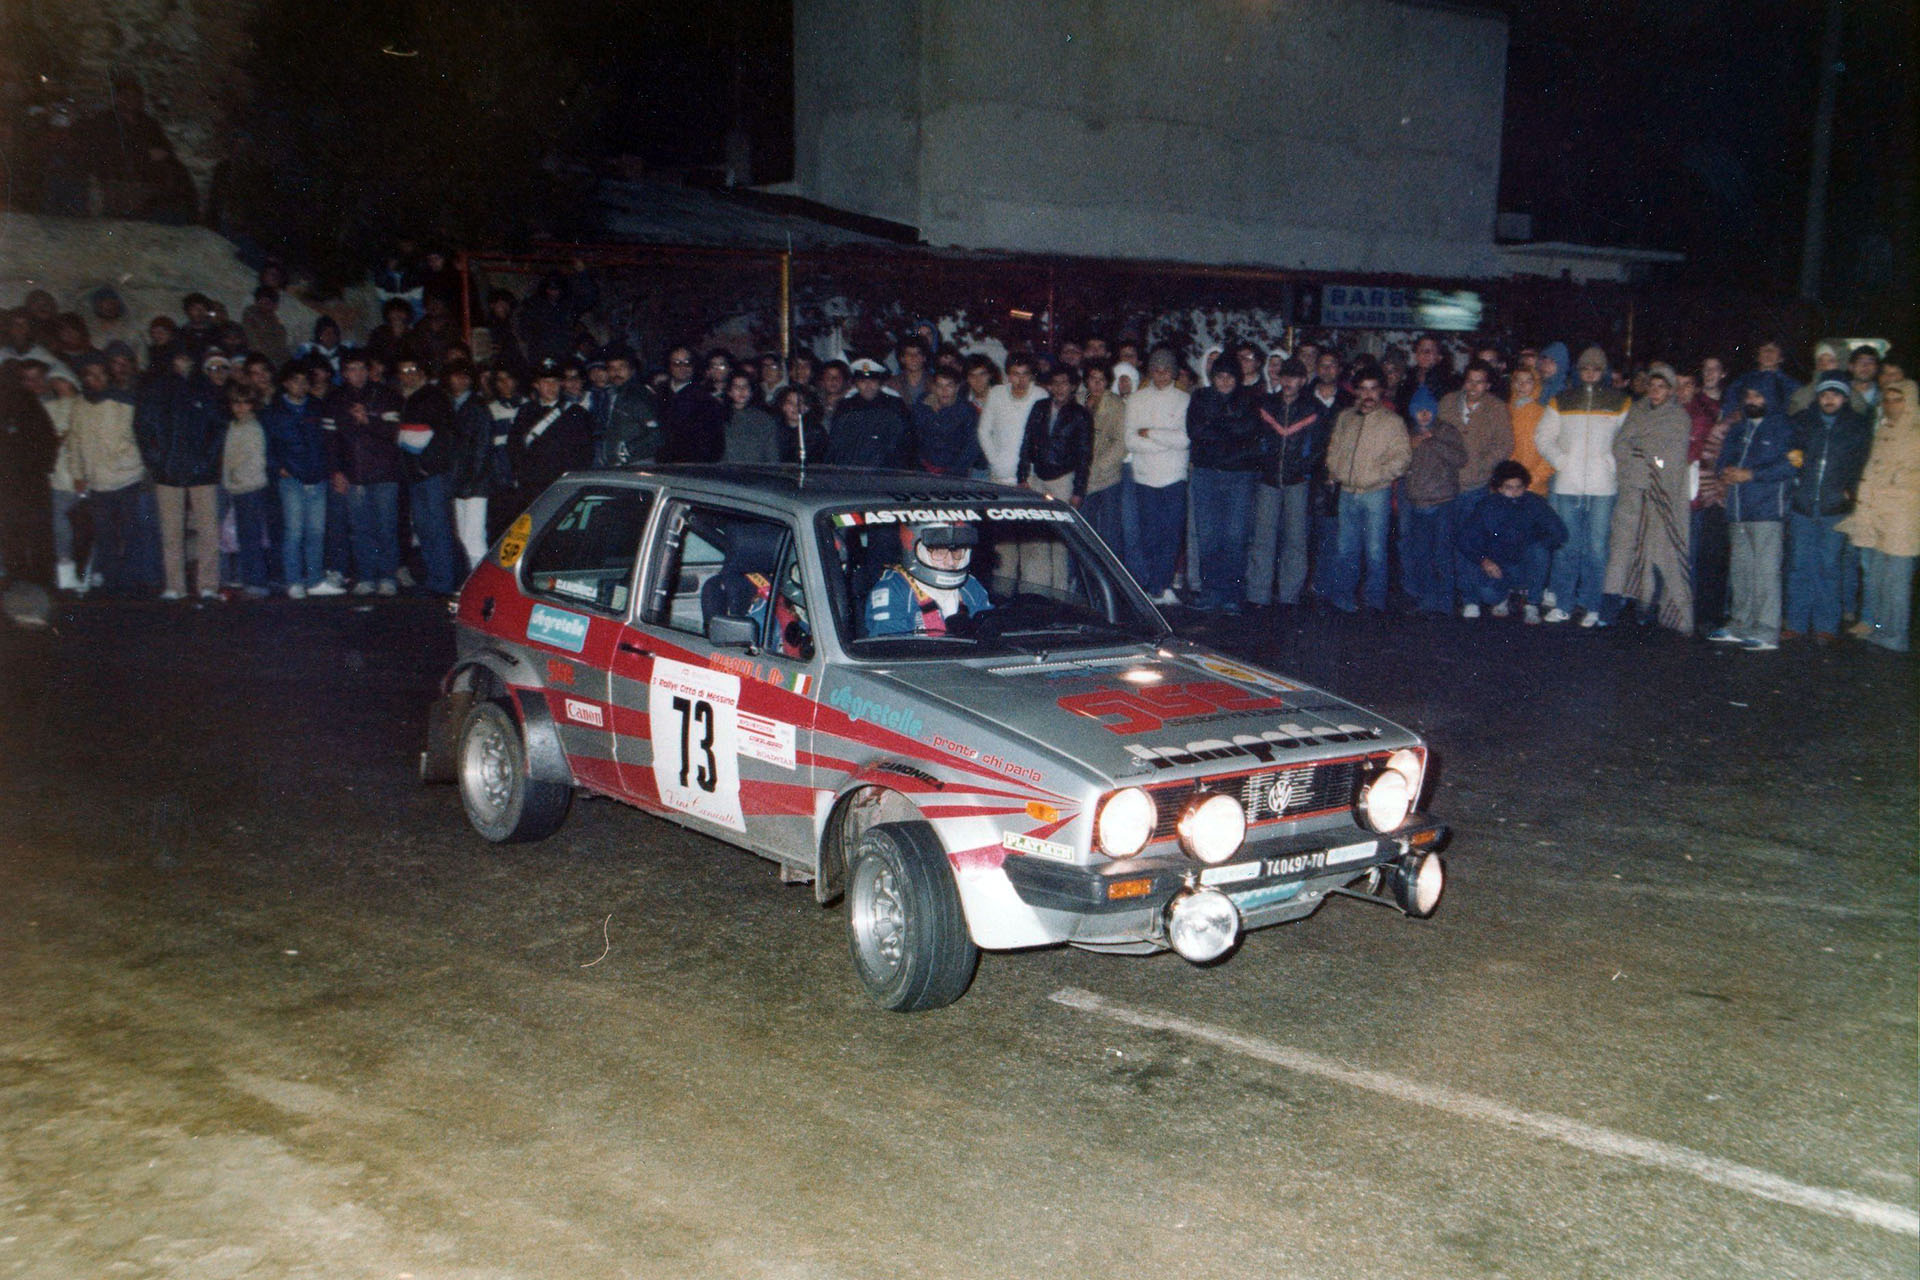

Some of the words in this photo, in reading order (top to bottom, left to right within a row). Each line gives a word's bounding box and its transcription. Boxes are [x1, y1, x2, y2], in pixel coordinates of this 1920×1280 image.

[864, 508, 982, 525] ASTIGIANA
[698, 690, 705, 698] di
[567, 702, 603, 725] Canon
[672, 695, 718, 793] 73
[981, 749, 1003, 769] chi
[1004, 759, 1042, 783] parla
